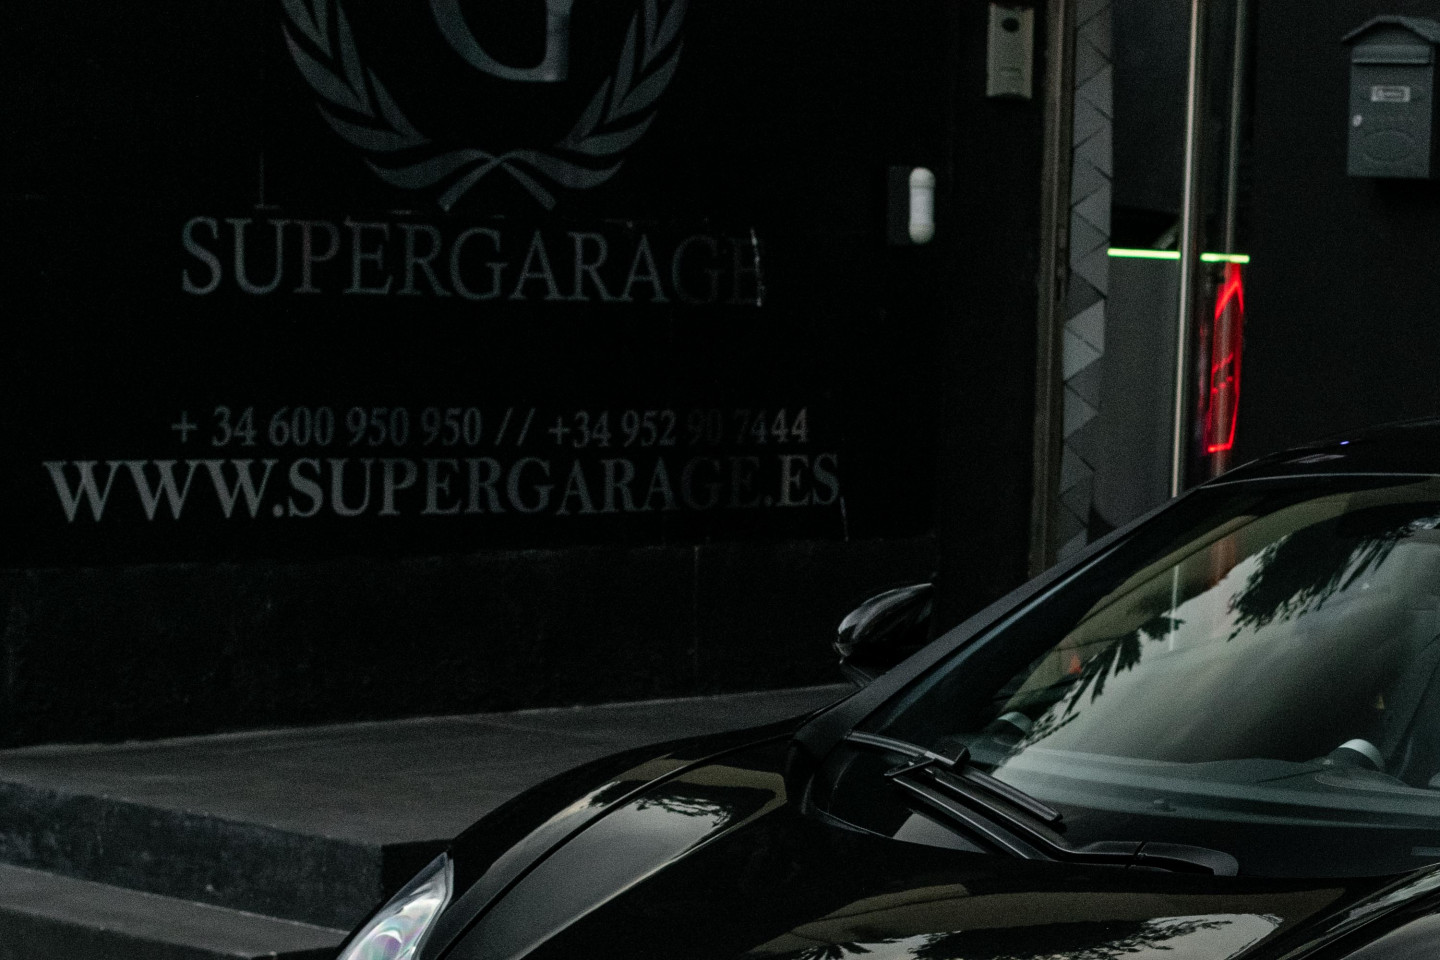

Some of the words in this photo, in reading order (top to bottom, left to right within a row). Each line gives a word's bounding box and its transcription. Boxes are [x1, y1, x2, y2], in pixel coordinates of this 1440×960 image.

[181, 214, 764, 304] SUPERGARAGE
[211, 405, 259, 448] 34
[267, 405, 336, 448] 600
[345, 405, 410, 448] 950
[419, 405, 484, 448] 950
[547, 409, 612, 449] +34
[620, 409, 678, 449] 952
[733, 406, 809, 446] 7444
[41, 453, 840, 523] WWW.SUPERGARAGE.ES
